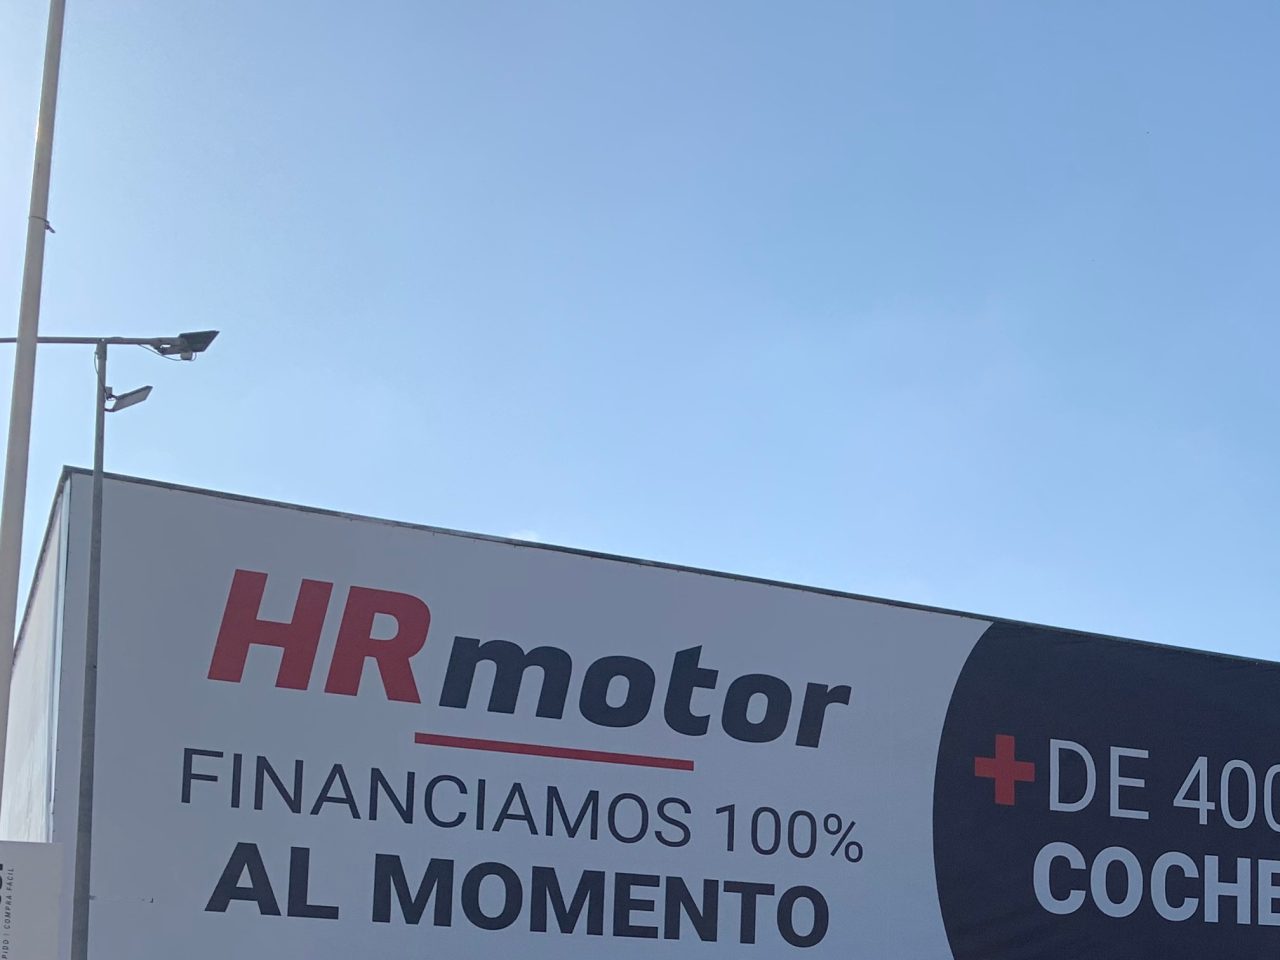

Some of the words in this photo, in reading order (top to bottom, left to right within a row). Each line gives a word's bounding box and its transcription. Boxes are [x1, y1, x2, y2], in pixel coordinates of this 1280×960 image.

[180, 747, 692, 848] FINANCIAMOS
[715, 803, 864, 863] 100%
[204, 841, 340, 921] AL
[371, 853, 830, 949] MOMENTO
